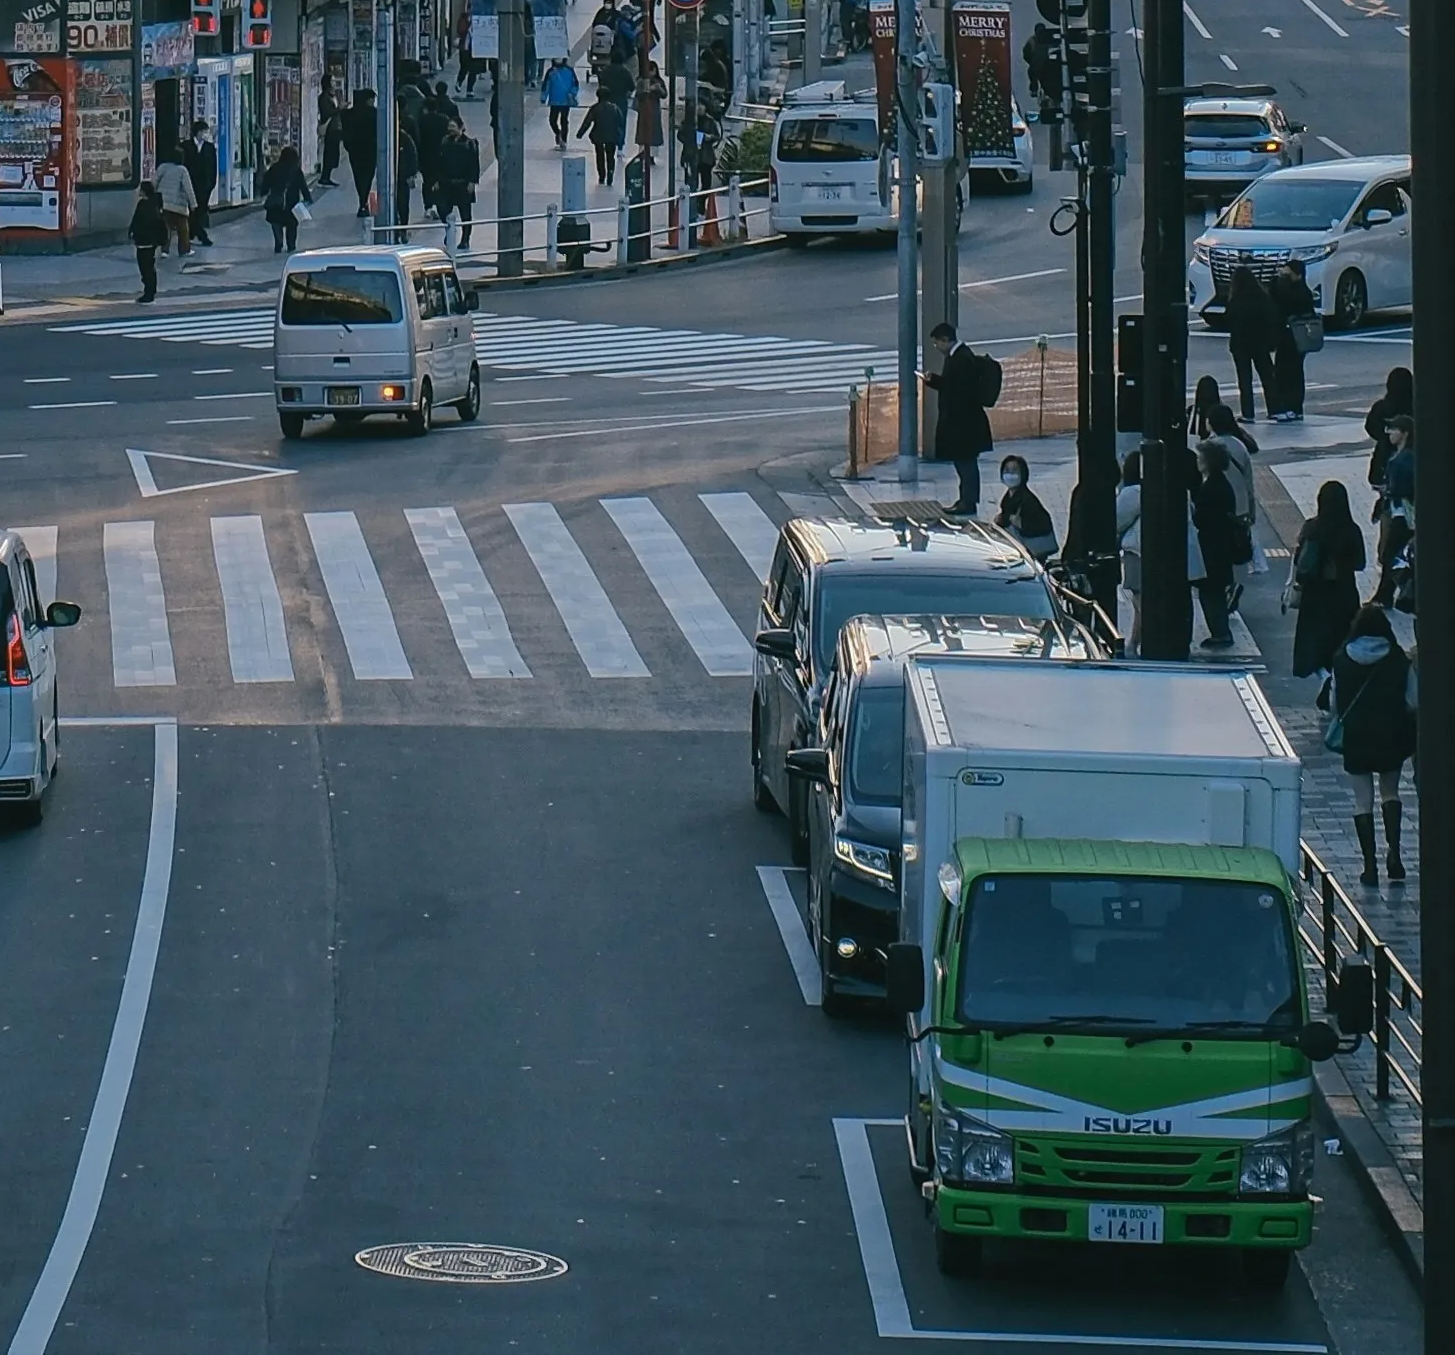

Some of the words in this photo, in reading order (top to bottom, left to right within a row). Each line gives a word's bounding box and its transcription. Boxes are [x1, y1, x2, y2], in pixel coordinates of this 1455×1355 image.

[22, 1, 57, 22] VISA
[958, 16, 1005, 29] MERRY
[958, 28, 1006, 39] CHRISTMAS
[1084, 1116, 1158, 1135] ISUZU
[1107, 1220, 1158, 1241] 14-11
